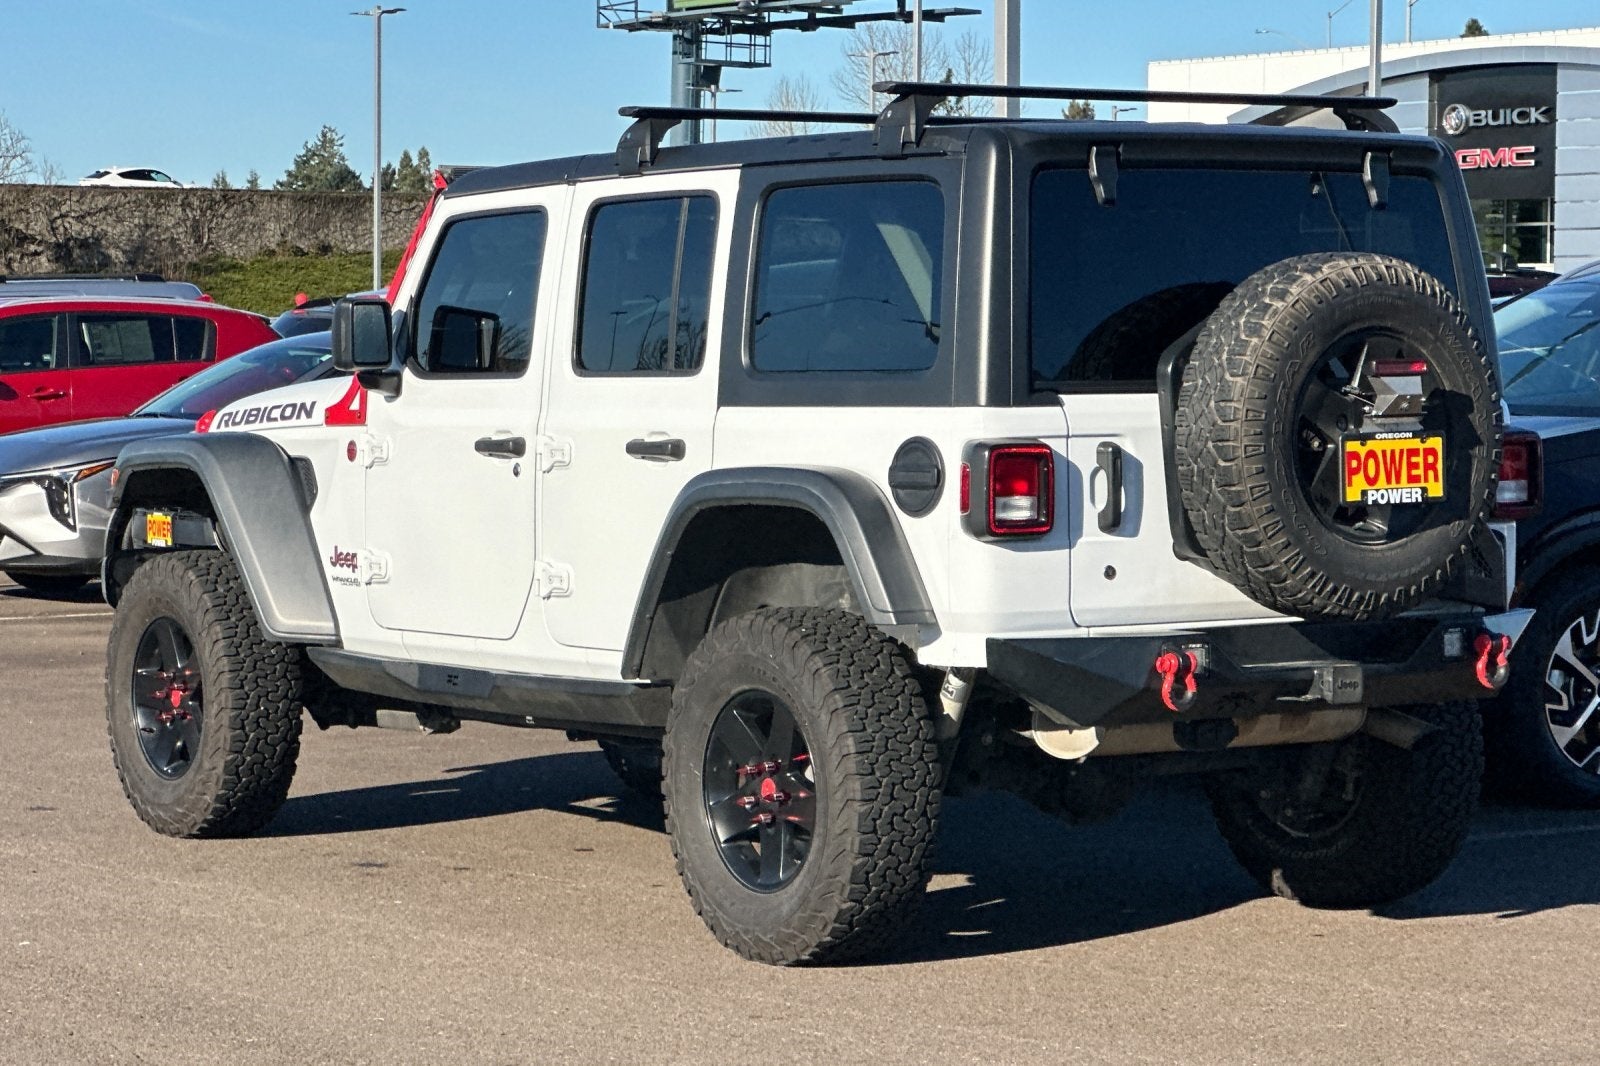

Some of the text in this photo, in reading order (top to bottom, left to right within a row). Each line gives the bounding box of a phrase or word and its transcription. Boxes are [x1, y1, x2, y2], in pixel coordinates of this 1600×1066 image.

[1469, 106, 1550, 127] BUICK
[1455, 146, 1535, 169] GMC
[216, 401, 317, 429] RUBICON
[1345, 447, 1440, 487] POWER
[1367, 488, 1422, 504] POWER
[147, 520, 172, 538] POWER
[330, 545, 358, 573] Jeep
[1337, 680, 1359, 690] Jeep
